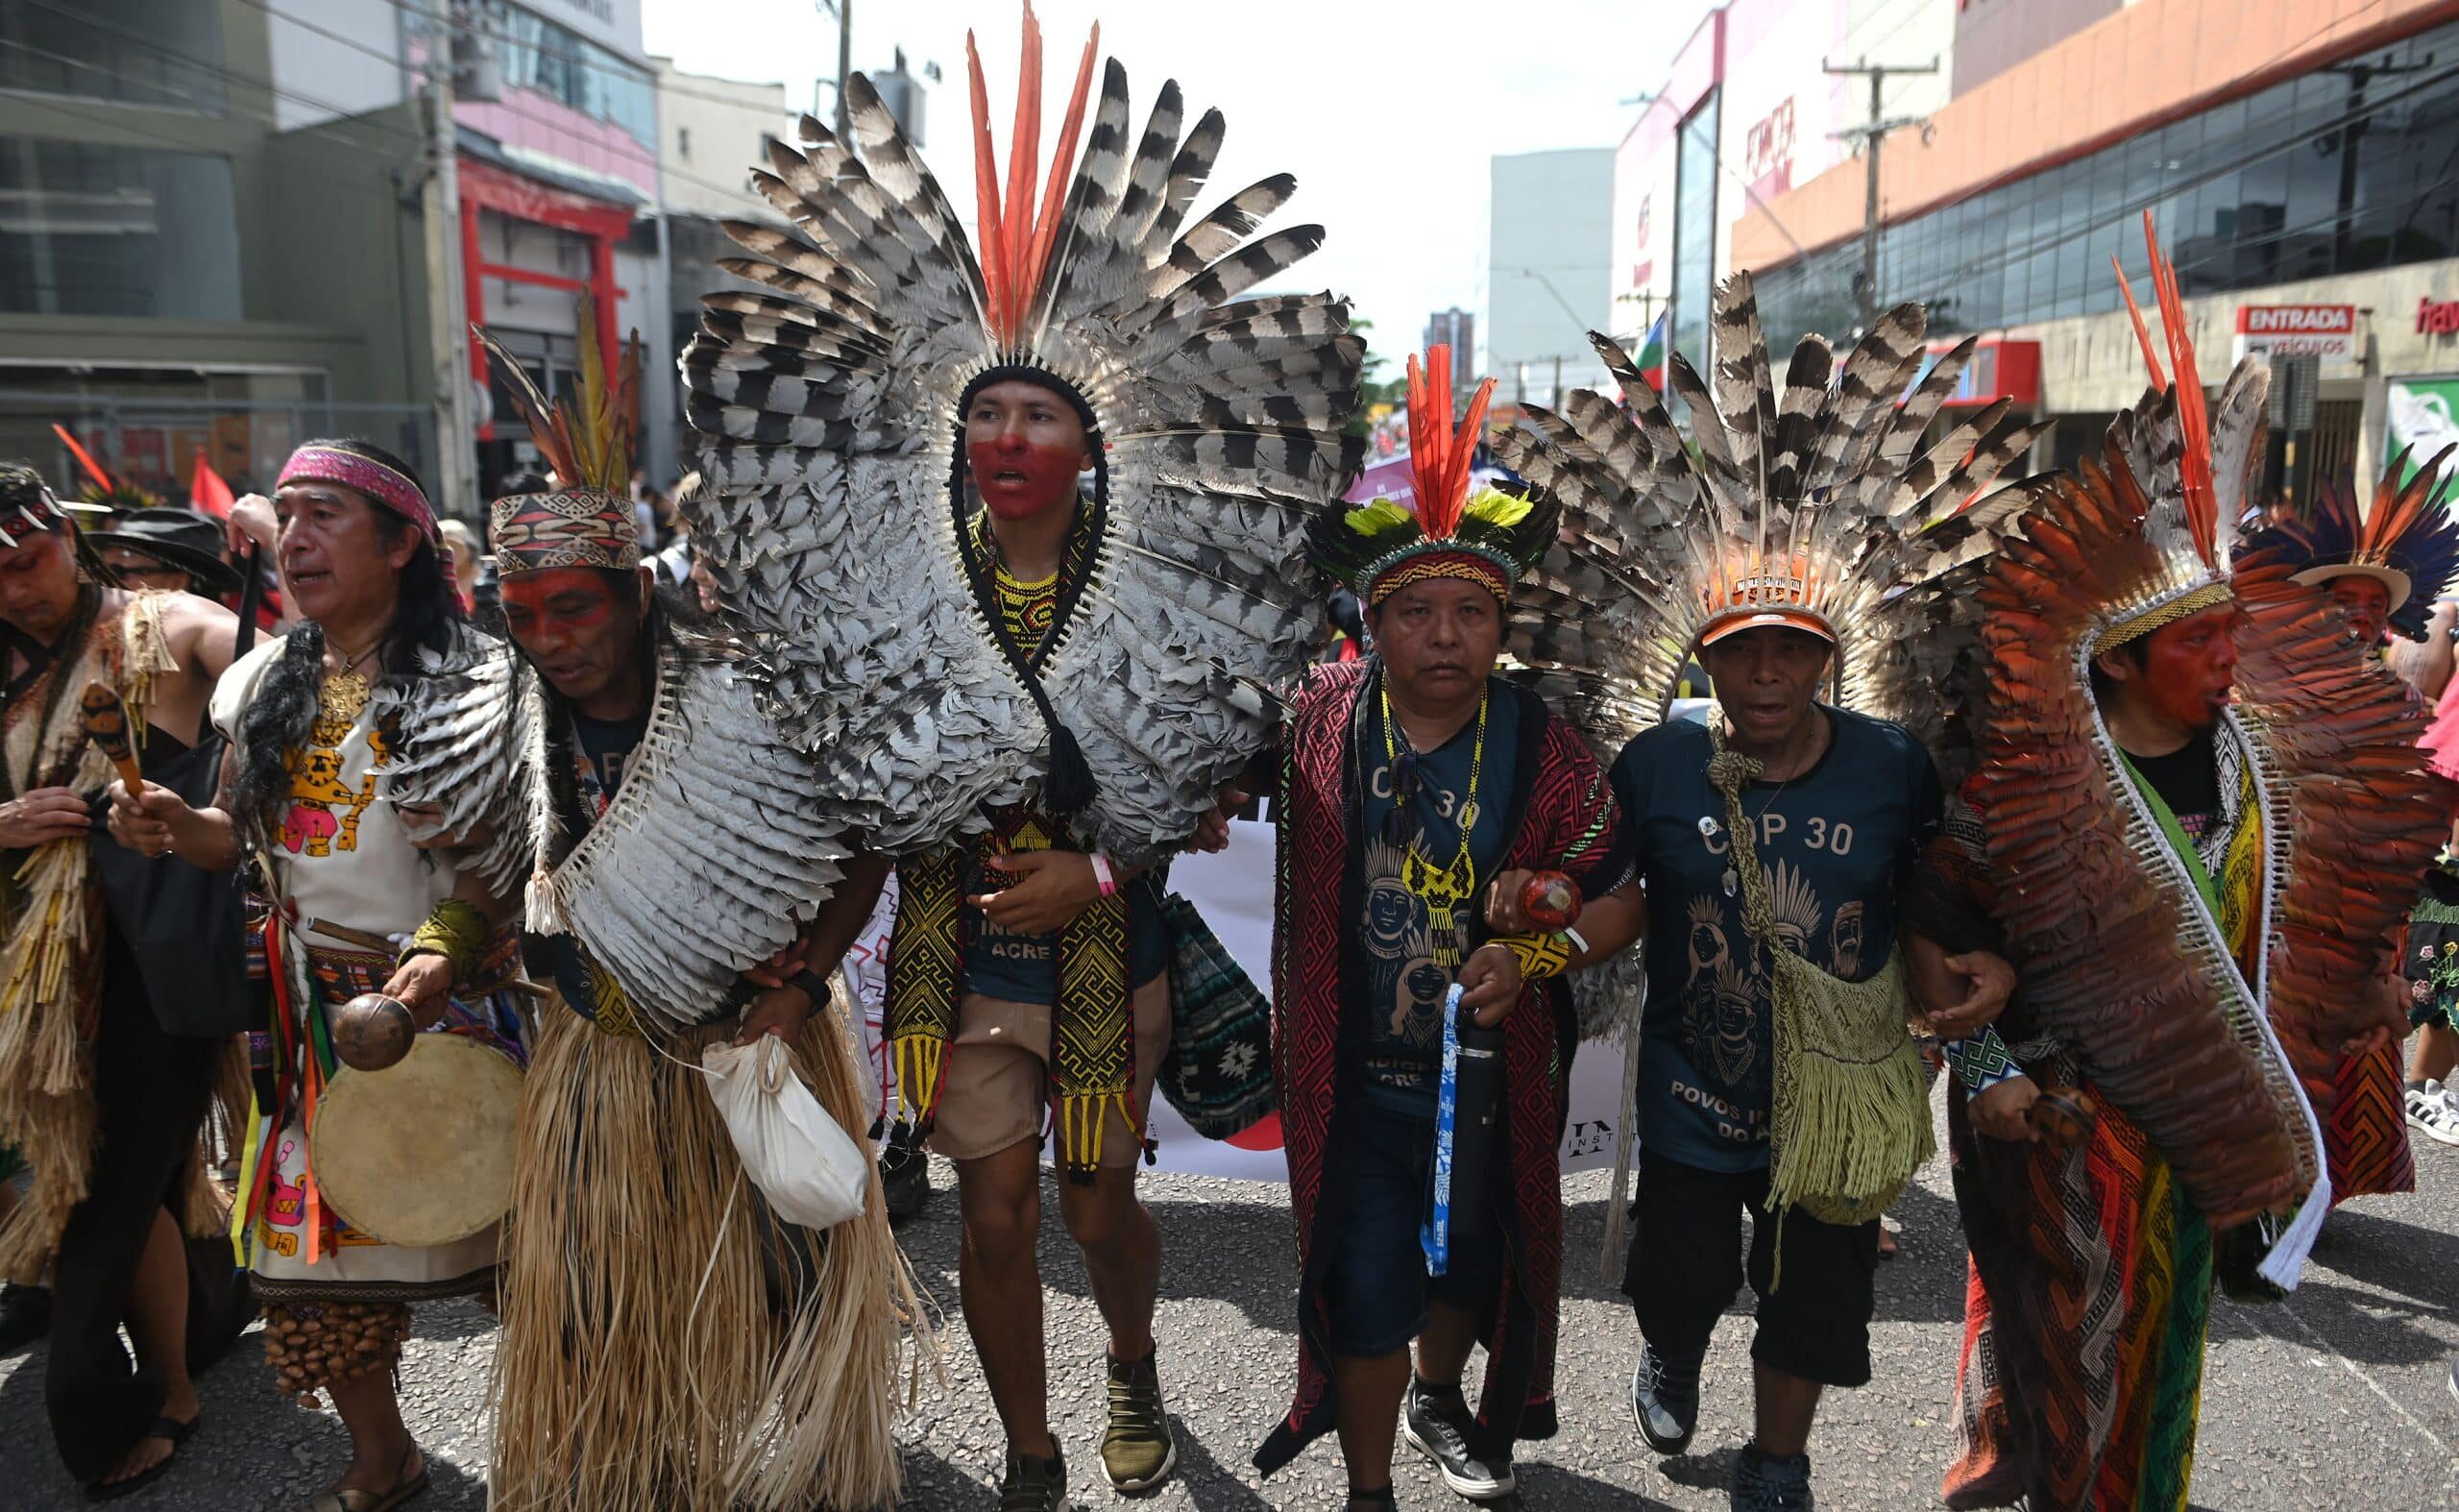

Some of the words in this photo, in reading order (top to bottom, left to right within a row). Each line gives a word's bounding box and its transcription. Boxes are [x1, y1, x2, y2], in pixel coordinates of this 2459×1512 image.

[2249, 308, 2349, 330] ENTRADA
[1435, 790, 1481, 831] 30
[1804, 817, 1852, 856] 30
[992, 942, 1050, 961] ACRE
[1377, 1073, 1423, 1087] CRE
[1670, 1079, 1741, 1122] POVOS
[1568, 1133, 1638, 1150] INSTT
[1717, 1121, 1749, 1142] DO
